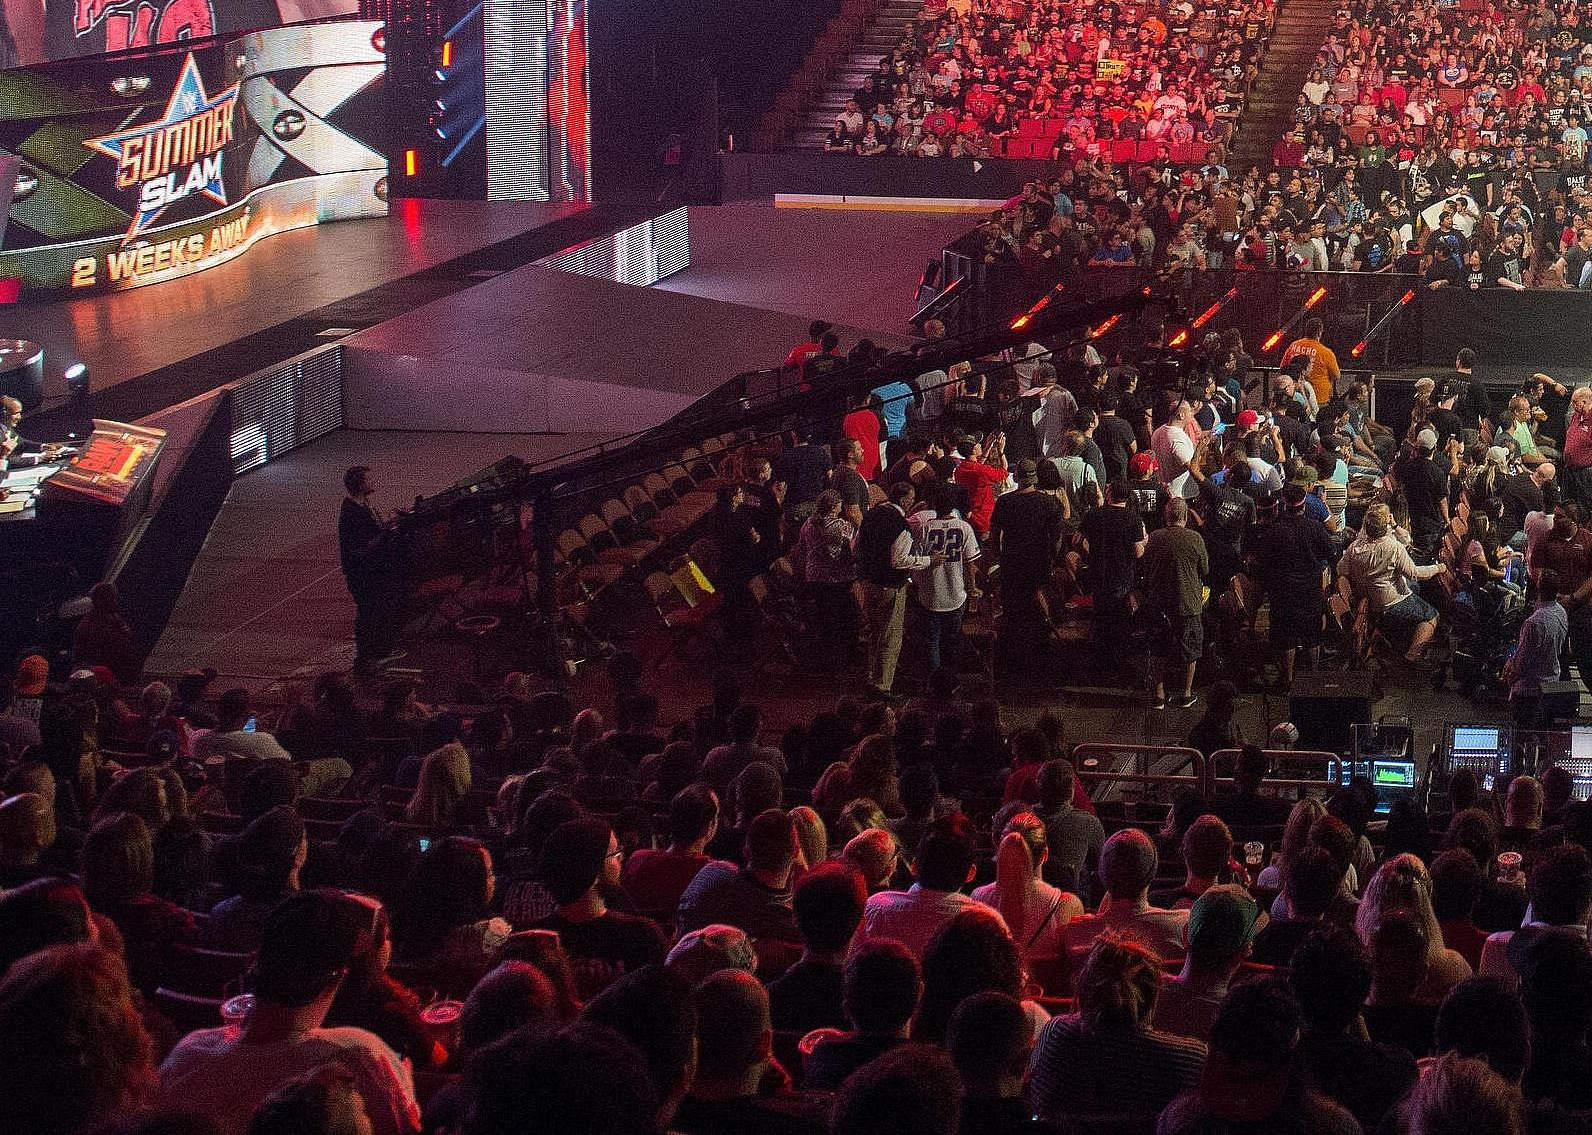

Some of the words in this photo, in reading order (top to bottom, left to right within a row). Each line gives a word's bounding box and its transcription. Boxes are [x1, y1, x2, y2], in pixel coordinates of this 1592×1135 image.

[117, 100, 234, 188] SUMMER
[140, 150, 224, 212] SLAM
[71, 255, 98, 289] 2
[107, 234, 205, 282] WEEKS
[209, 211, 252, 256] AWAY
[928, 528, 964, 562] 22
